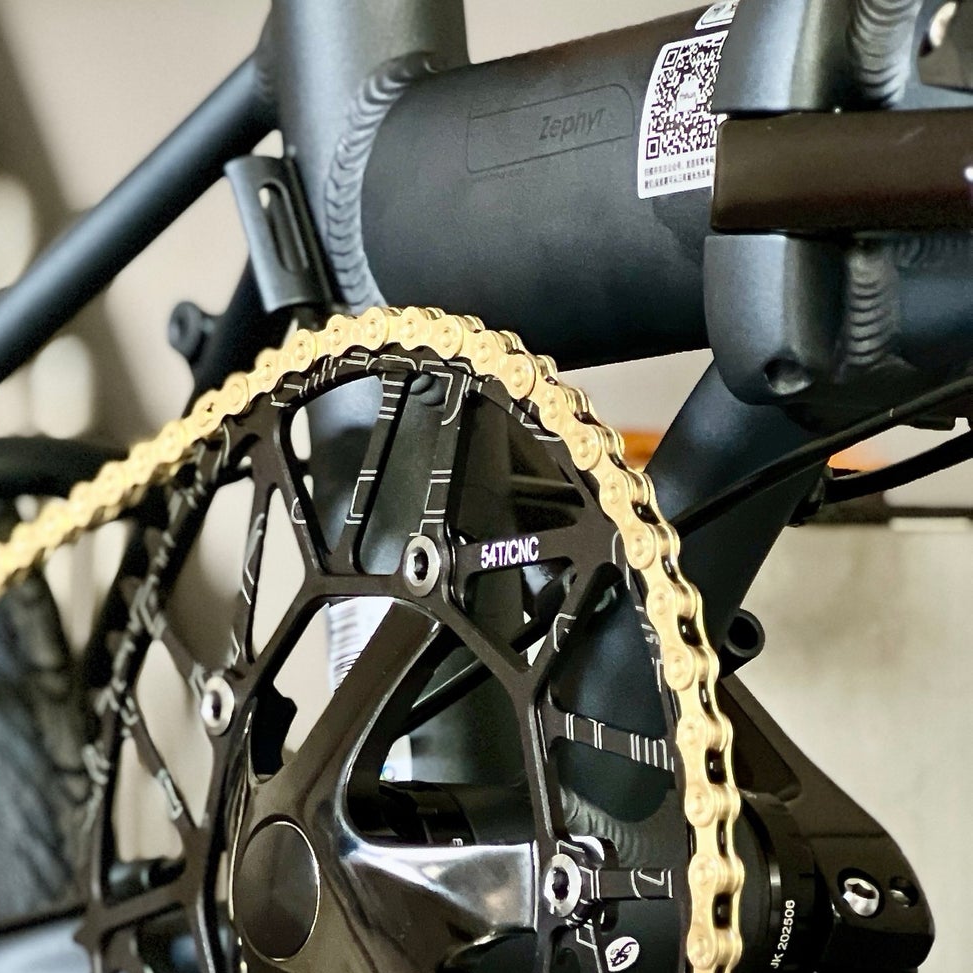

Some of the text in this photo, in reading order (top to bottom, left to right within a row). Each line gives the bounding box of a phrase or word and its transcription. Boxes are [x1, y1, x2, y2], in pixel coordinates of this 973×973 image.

[538, 107, 606, 141] Zephyr
[480, 536, 539, 569] 54T/CNC
[770, 953, 784, 969] JK
